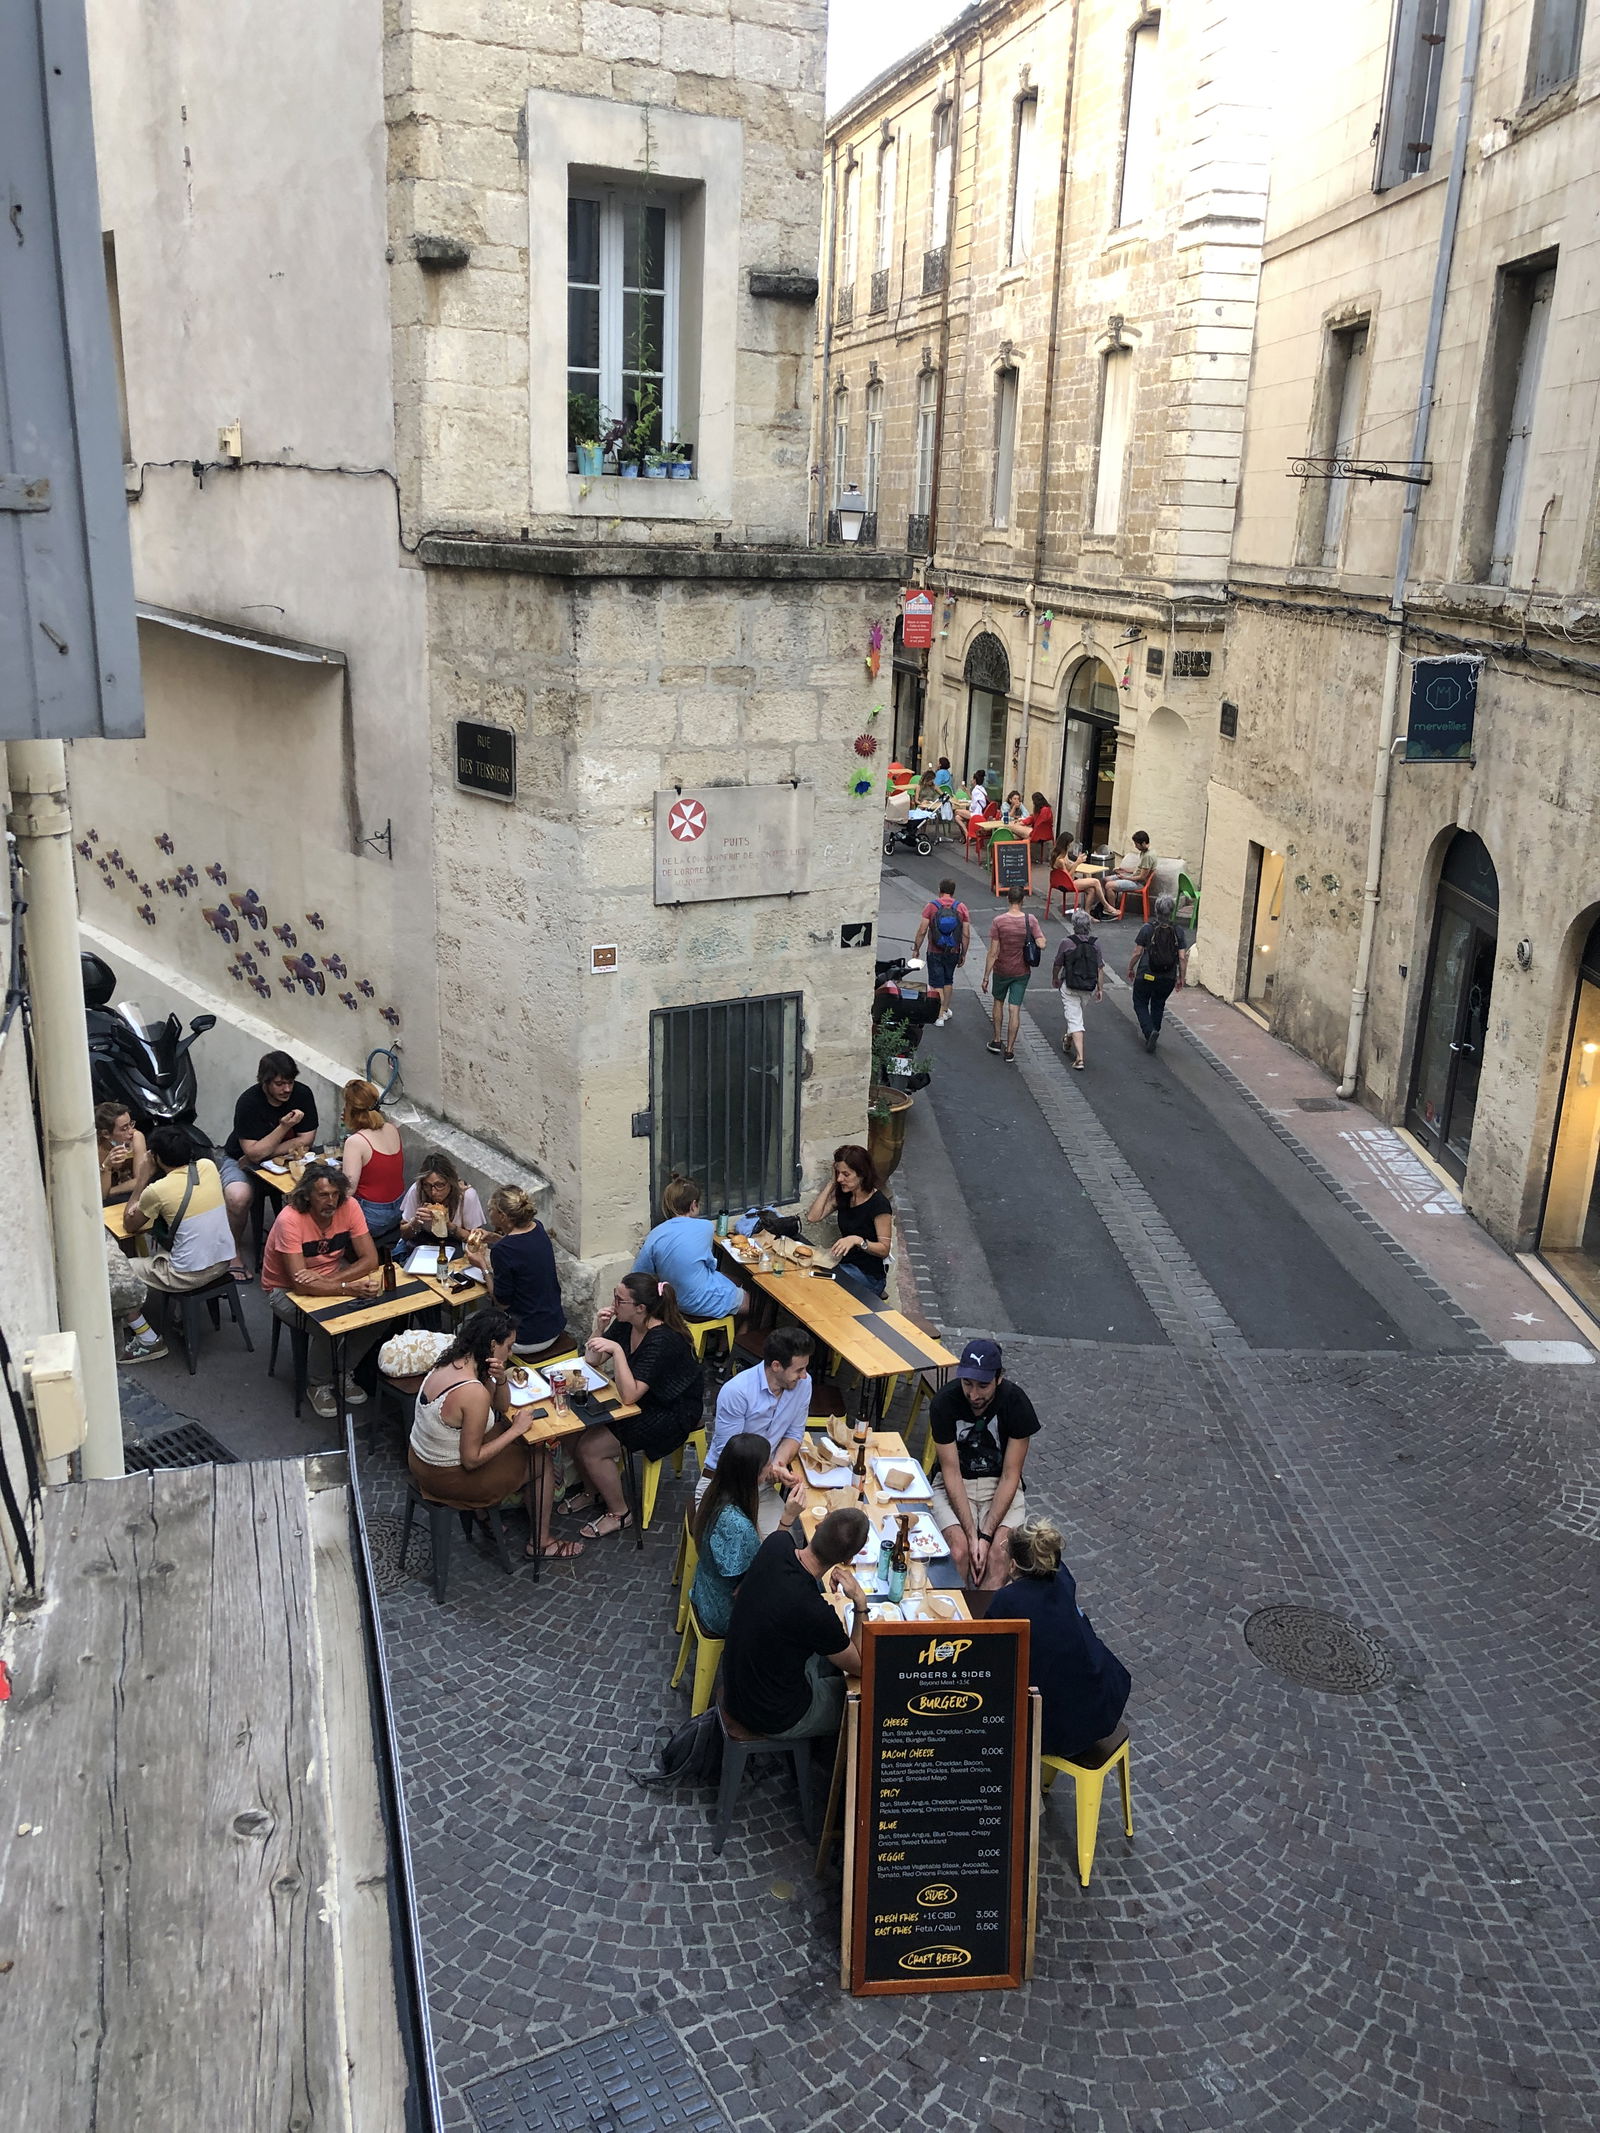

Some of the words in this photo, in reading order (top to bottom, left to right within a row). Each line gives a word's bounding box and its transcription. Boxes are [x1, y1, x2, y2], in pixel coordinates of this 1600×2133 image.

[1414, 721, 1467, 731] merveilles
[477, 734, 491, 749] RUE
[460, 757, 473, 775] DES
[475, 761, 510, 784] TEISSIERS
[723, 837, 750, 848] PUITS
[918, 1638, 973, 1666] HOP
[899, 1671, 948, 1679] BURGERS
[961, 1670, 992, 1678] SIDES
[919, 1695, 969, 1710] BURGERS
[882, 1717, 909, 1727] CHEESE
[982, 1715, 1005, 1724] 8,00€
[881, 1749, 907, 1760] BACON
[909, 1748, 935, 1758] CHEESE
[880, 1788, 901, 1798] SPICY
[980, 1784, 1002, 1794] 9,00€
[879, 1820, 898, 1830] BLUE
[979, 1816, 1001, 1826] 9,00€
[878, 1851, 905, 1862] VEGGIE
[978, 1848, 1000, 1858] 9,00€
[924, 1888, 949, 1901] SIDES
[874, 1912, 898, 1923] FRESH
[899, 1911, 919, 1922] FRIES
[937, 1911, 957, 1919] CBD
[975, 1910, 999, 1919] 3,50€
[892, 1925, 912, 1935] FRIES
[915, 1925, 933, 1933] Feta
[938, 1923, 961, 1933] Cajun
[975, 1922, 999, 1931] 5,50€
[907, 1952, 934, 1965] CRAFT
[936, 1951, 963, 1965] BEERS
